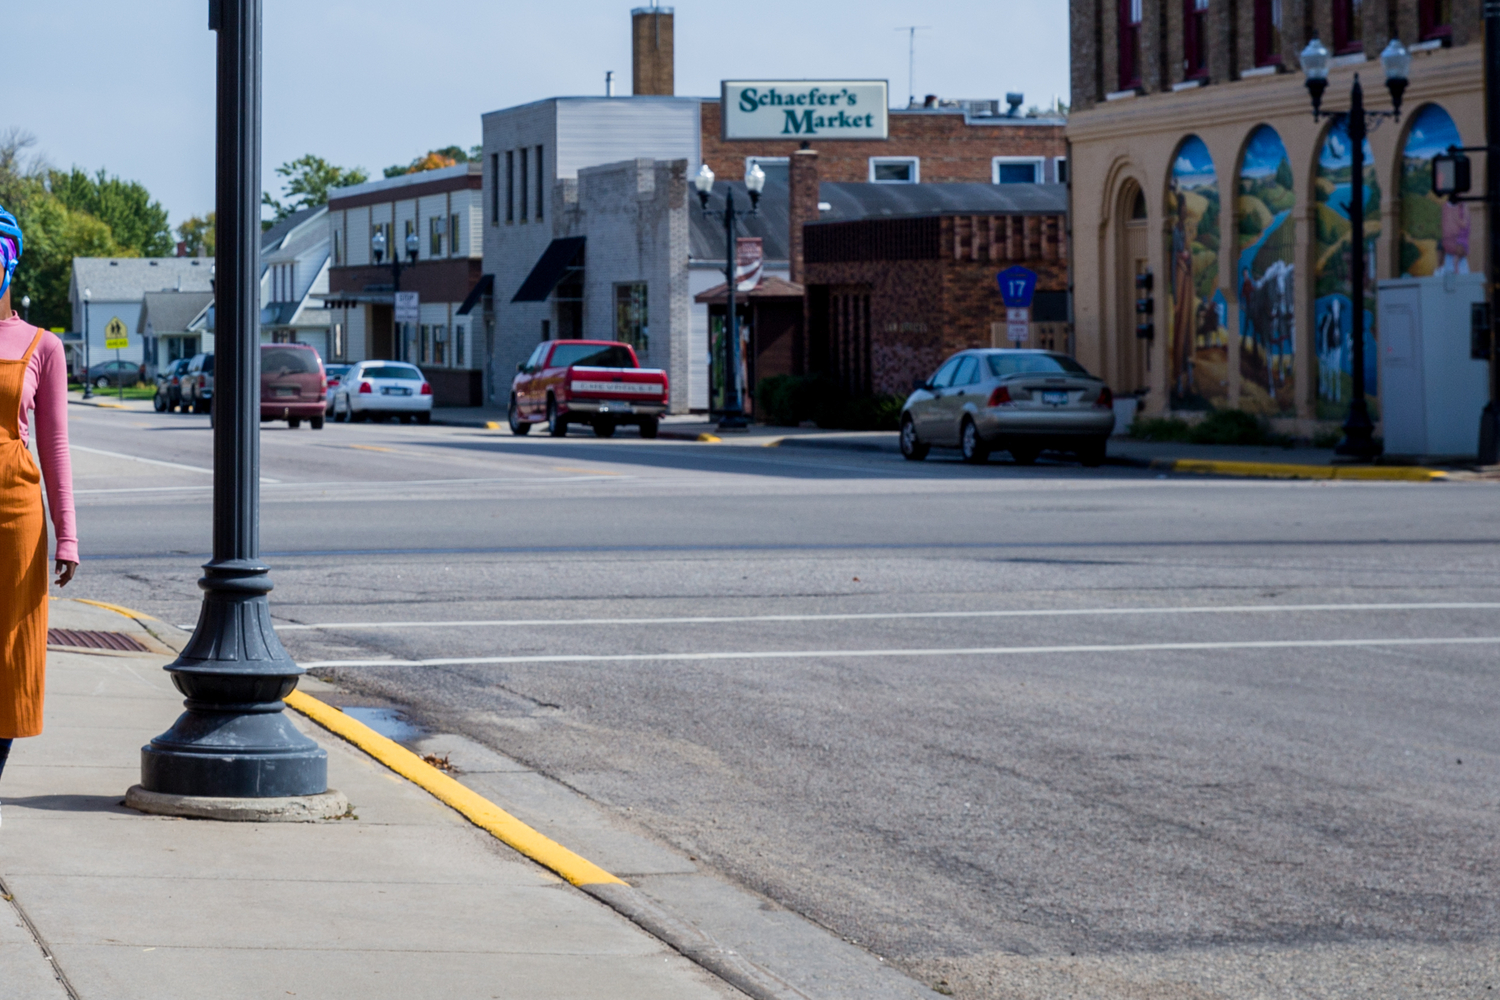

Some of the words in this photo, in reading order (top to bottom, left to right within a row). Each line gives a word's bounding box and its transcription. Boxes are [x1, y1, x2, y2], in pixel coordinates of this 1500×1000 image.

[739, 87, 858, 113] Schaefer's
[781, 109, 874, 134] Market
[1009, 280, 1026, 298] 17
